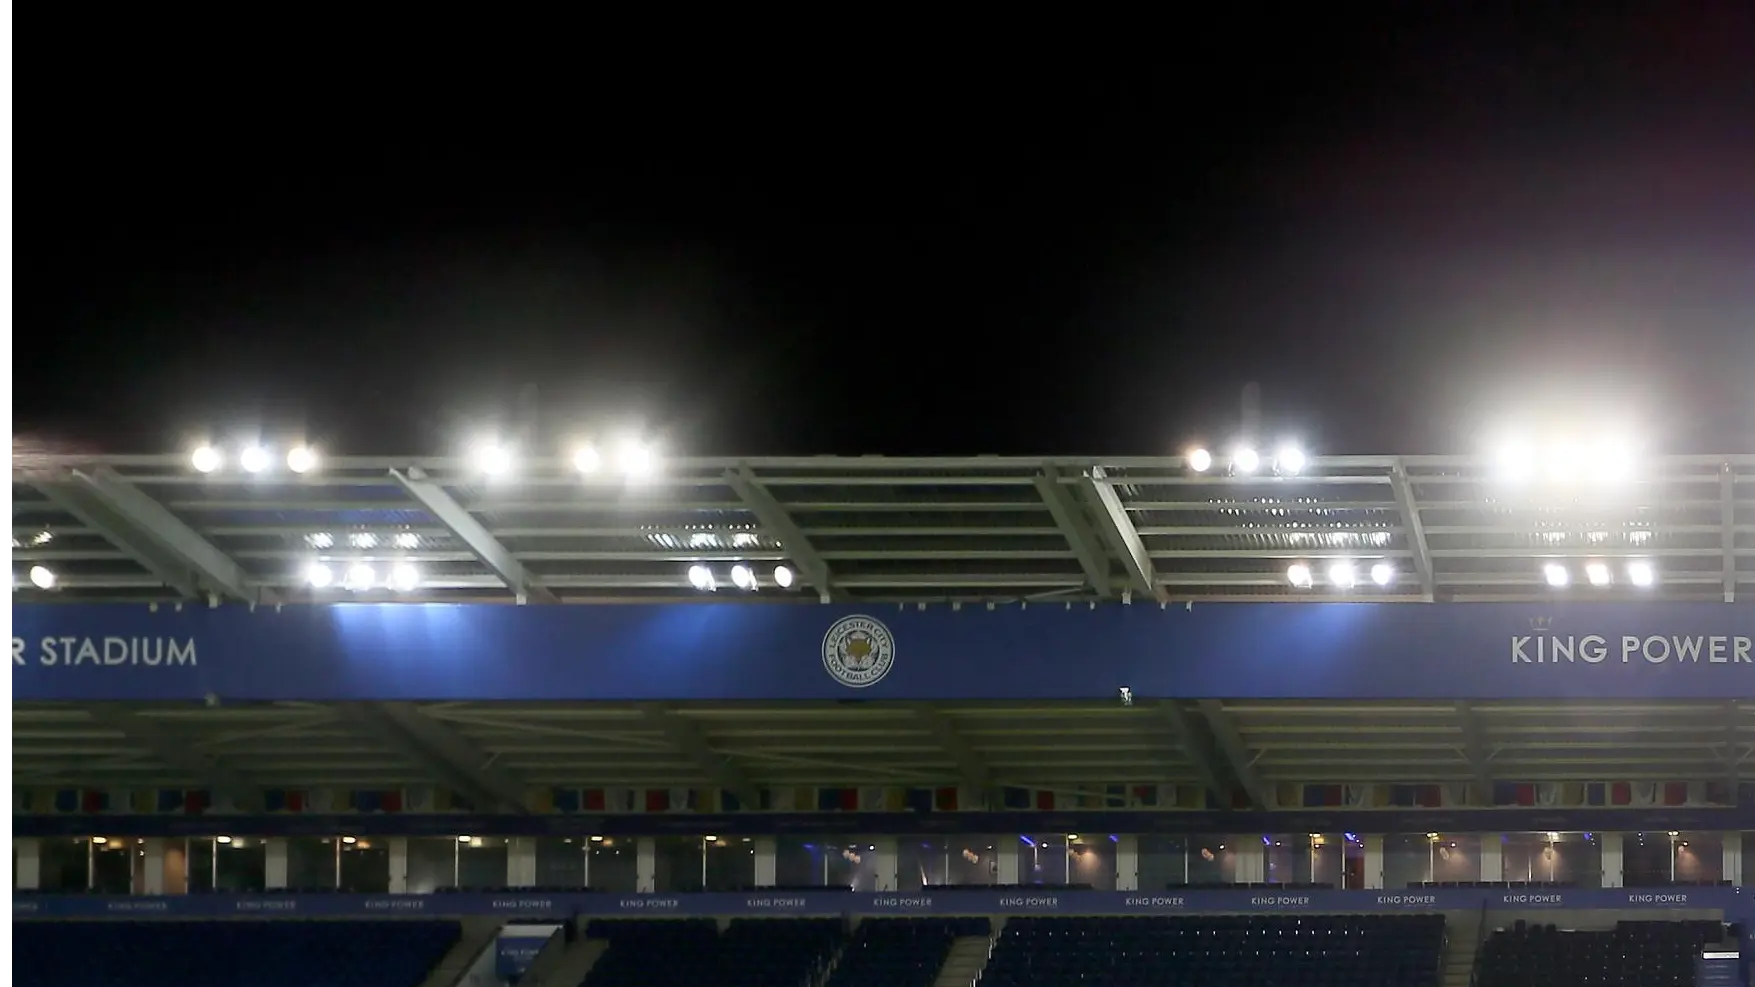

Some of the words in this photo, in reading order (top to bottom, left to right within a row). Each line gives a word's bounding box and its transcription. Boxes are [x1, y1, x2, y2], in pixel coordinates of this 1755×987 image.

[828, 621, 874, 649] LEICESTER
[874, 628, 888, 648] CITY
[40, 637, 197, 666] STADIUM
[1511, 634, 1608, 663] KING
[1622, 634, 1752, 663] POWER
[747, 898, 770, 907] KING
[773, 898, 806, 907] POWER
[873, 898, 897, 906] KING
[899, 898, 932, 906] POWER
[999, 897, 1023, 906] KING
[1025, 897, 1058, 906] POWER
[1125, 897, 1148, 906] KING
[1151, 897, 1184, 906] POWER
[1251, 896, 1274, 905] KING
[1277, 896, 1310, 905] POWER
[1377, 895, 1400, 904] KING
[1403, 895, 1436, 904] POWER
[1503, 894, 1526, 903] KING
[1529, 894, 1562, 903] POWER
[1628, 894, 1652, 903] KING
[1655, 894, 1687, 903] POWER
[492, 900, 516, 908] KING
[518, 900, 552, 908] POWER
[620, 899, 643, 908] KING
[646, 899, 679, 908] POWER
